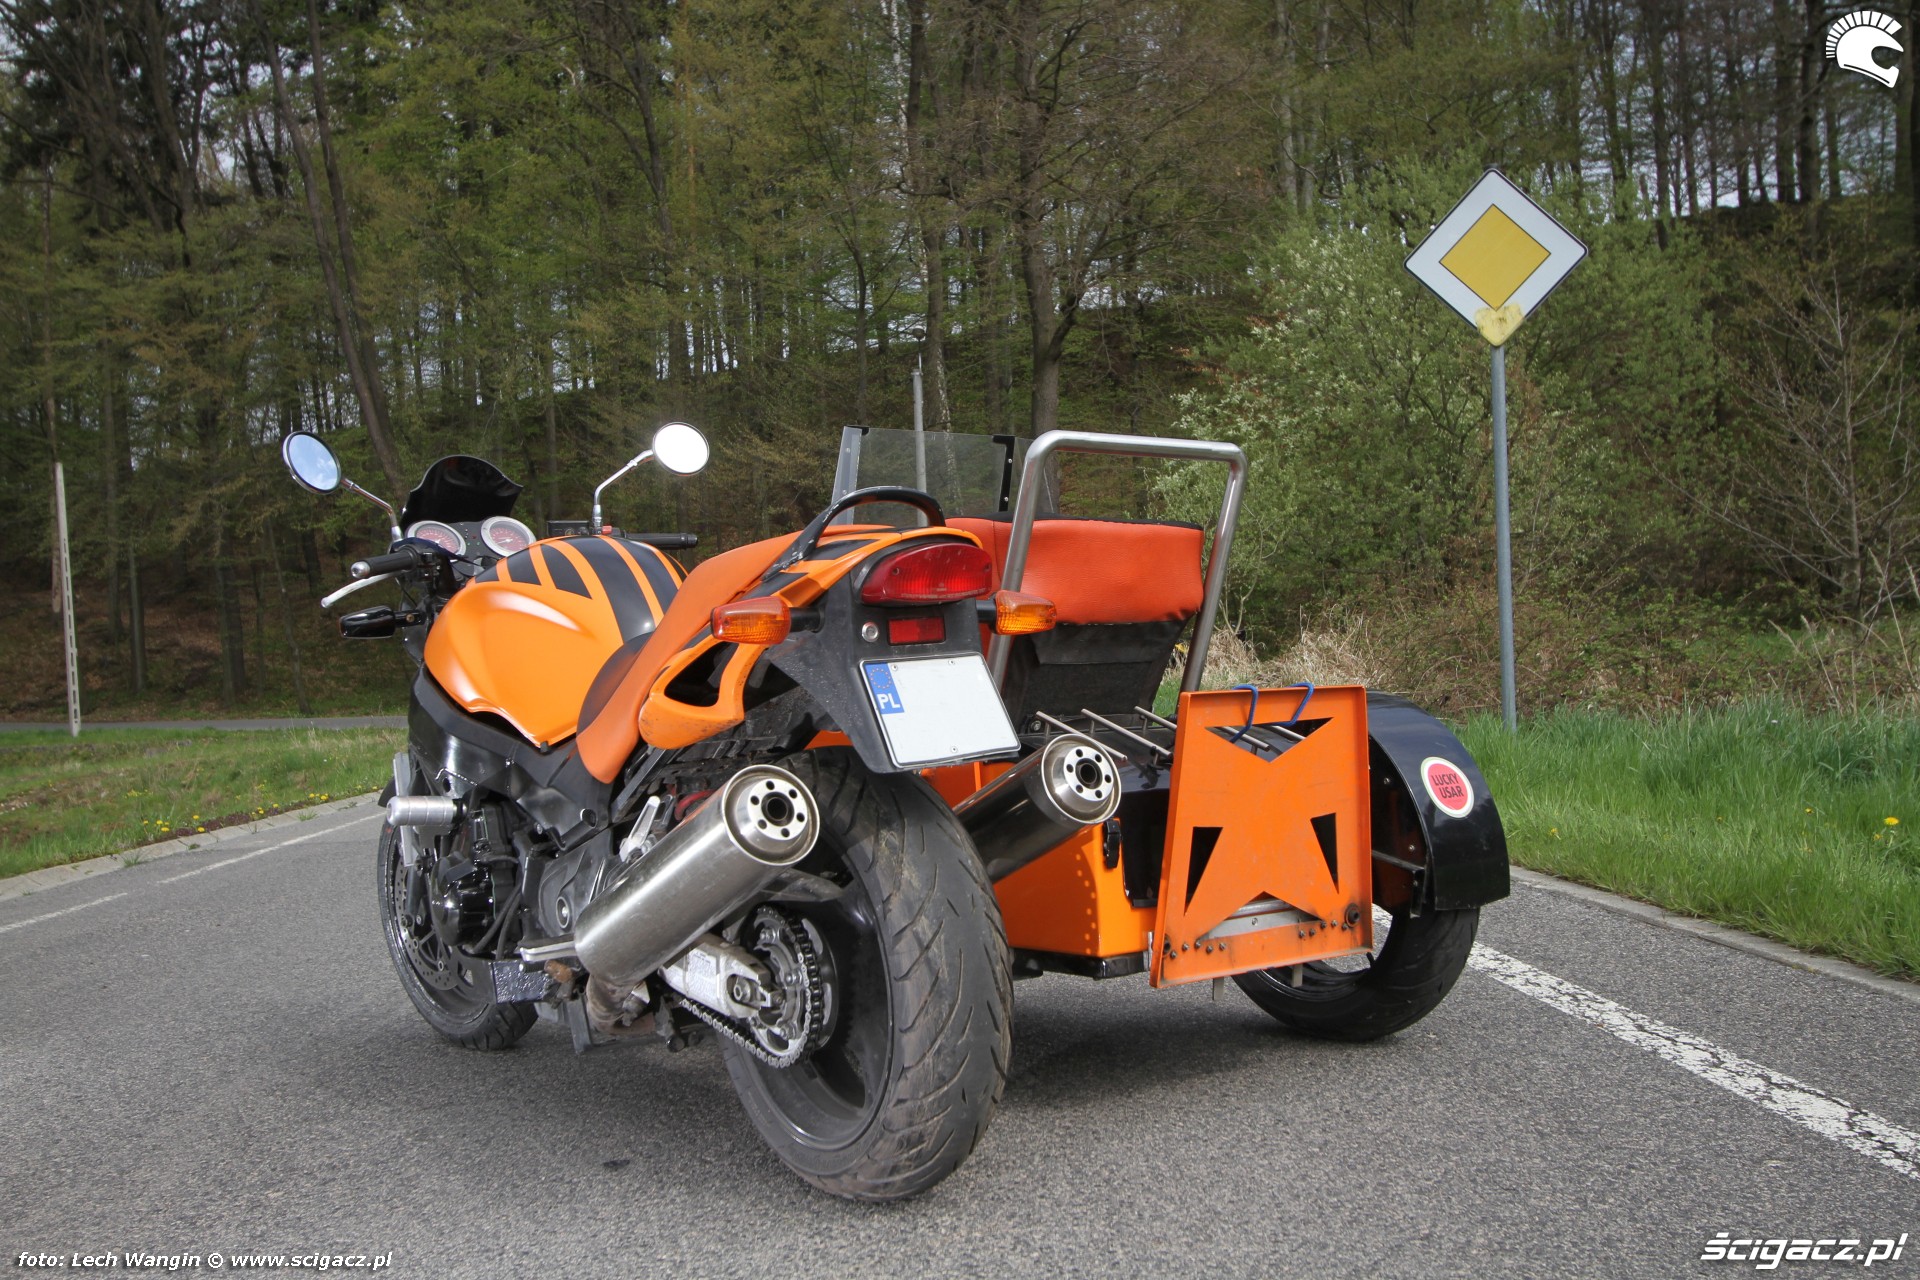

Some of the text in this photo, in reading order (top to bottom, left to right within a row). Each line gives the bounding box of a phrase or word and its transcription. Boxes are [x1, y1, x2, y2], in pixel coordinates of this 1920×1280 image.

[876, 693, 901, 710] PL
[1431, 773, 1459, 786] LUCKY
[1439, 785, 1464, 799] USAR
